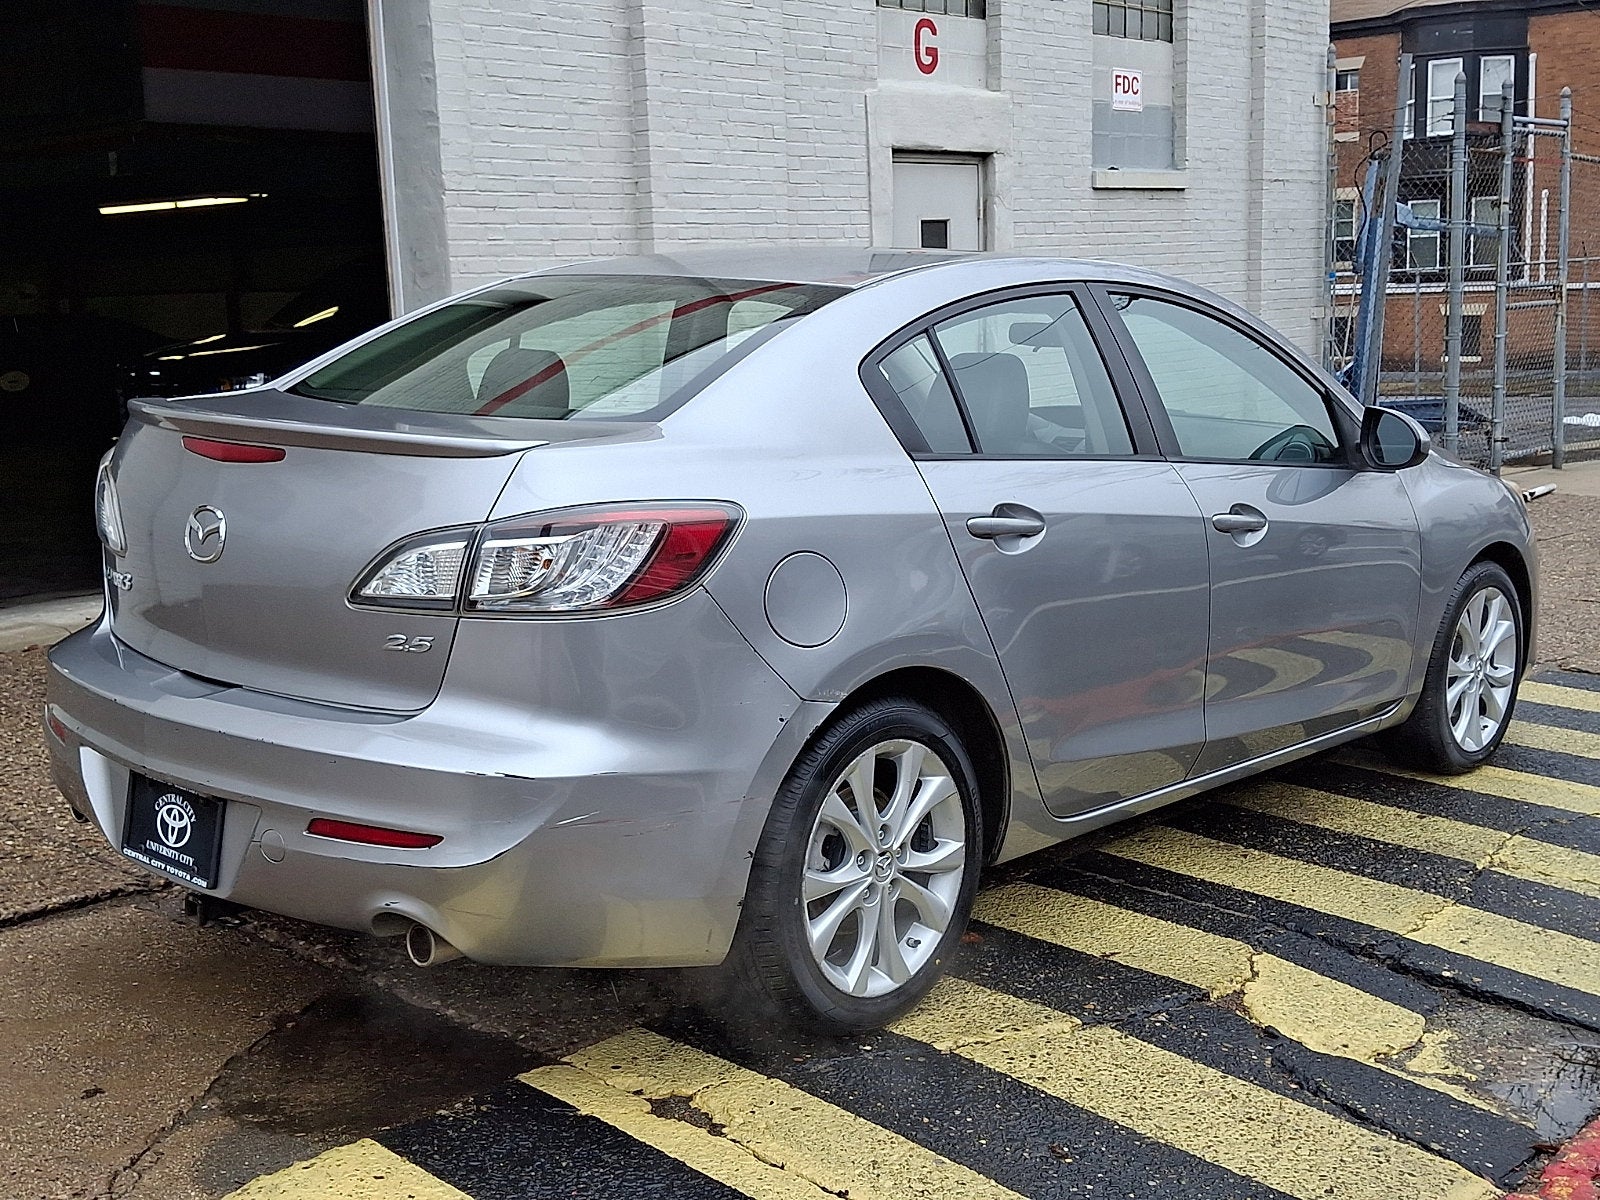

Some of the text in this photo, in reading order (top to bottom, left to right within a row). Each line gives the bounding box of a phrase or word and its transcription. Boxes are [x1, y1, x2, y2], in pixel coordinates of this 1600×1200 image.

[914, 17, 939, 75] G
[1115, 74, 1139, 95] FDC
[383, 634, 435, 653] 2.5
[154, 794, 197, 823] CENTRAL CITY
[123, 847, 150, 864] CENTRAL
[150, 859, 166, 870] CITY
[166, 864, 191, 881] TOYOTA
[146, 839, 195, 867] UNIVERSITY CITY
